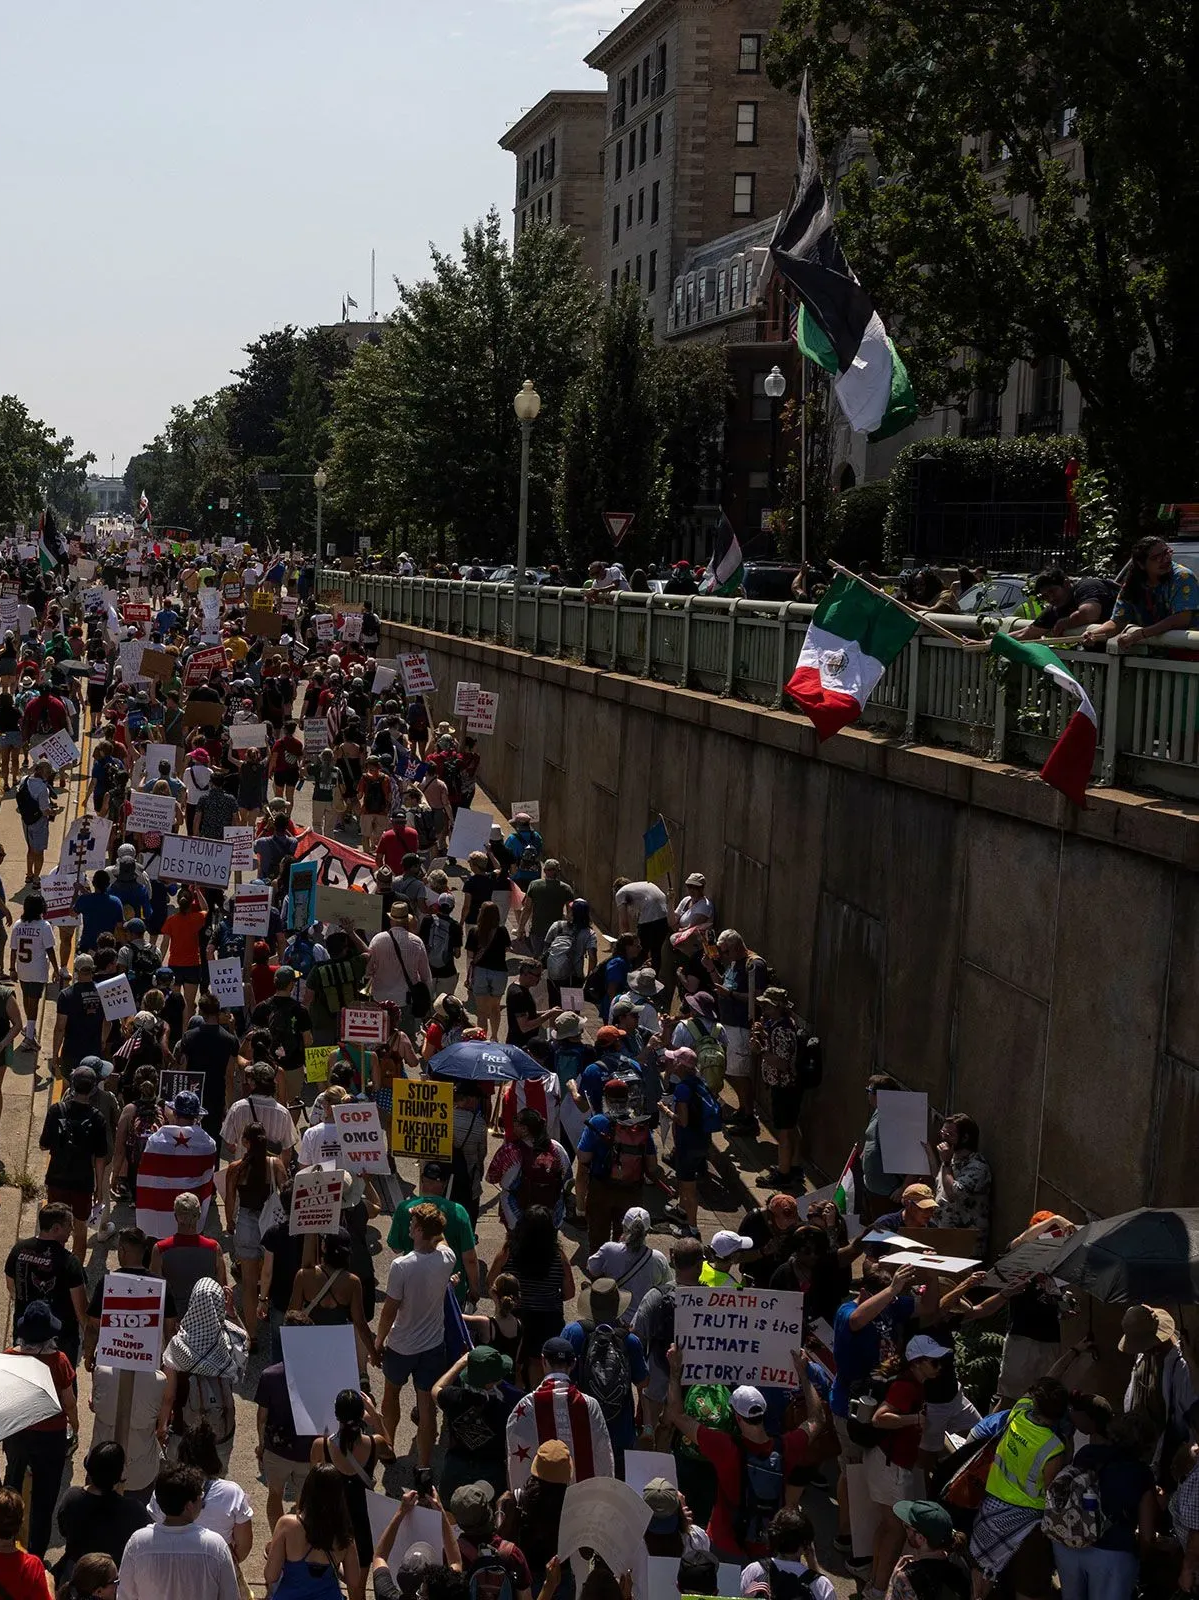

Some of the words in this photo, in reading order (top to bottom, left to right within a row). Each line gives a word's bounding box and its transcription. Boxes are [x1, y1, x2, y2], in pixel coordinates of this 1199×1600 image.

[42, 742, 65, 766] SOMOS
[49, 737, 72, 762] TODOS
[131, 811, 168, 820] OCCUPATION
[181, 840, 223, 857] TRUMP
[163, 857, 227, 879] DESTROYS
[236, 905, 267, 913] PROTEJA
[16, 927, 40, 937] DANIELS
[19, 938, 32, 963] 5
[104, 990, 128, 998] GAZA
[106, 985, 122, 993] LET
[108, 997, 128, 1006] LIVE
[482, 1052, 508, 1063] FREE
[487, 1065, 505, 1074] DC
[408, 1083, 438, 1100] STOP
[398, 1100, 447, 1119] TRUMP'S
[341, 1111, 372, 1123] GOP
[397, 1120, 448, 1138] TAKEOVER
[343, 1131, 378, 1143] OMG
[404, 1136, 419, 1151] OF
[421, 1137, 440, 1153] DC!
[347, 1151, 381, 1162] WTF
[300, 1194, 334, 1208] HAVE
[17, 1253, 51, 1266] CHAMPS
[681, 1294, 703, 1306] The
[708, 1292, 757, 1307] DEATH
[761, 1298, 778, 1310] of
[110, 1314, 151, 1328] STOP
[693, 1313, 748, 1328] TRUTH
[754, 1319, 767, 1330] is
[772, 1319, 799, 1334] the
[123, 1332, 134, 1340] the
[112, 1338, 144, 1349] TRUMP
[676, 1335, 760, 1354] ULTIMATE
[101, 1347, 153, 1361] TAKEOVER
[746, 1367, 758, 1380] of
